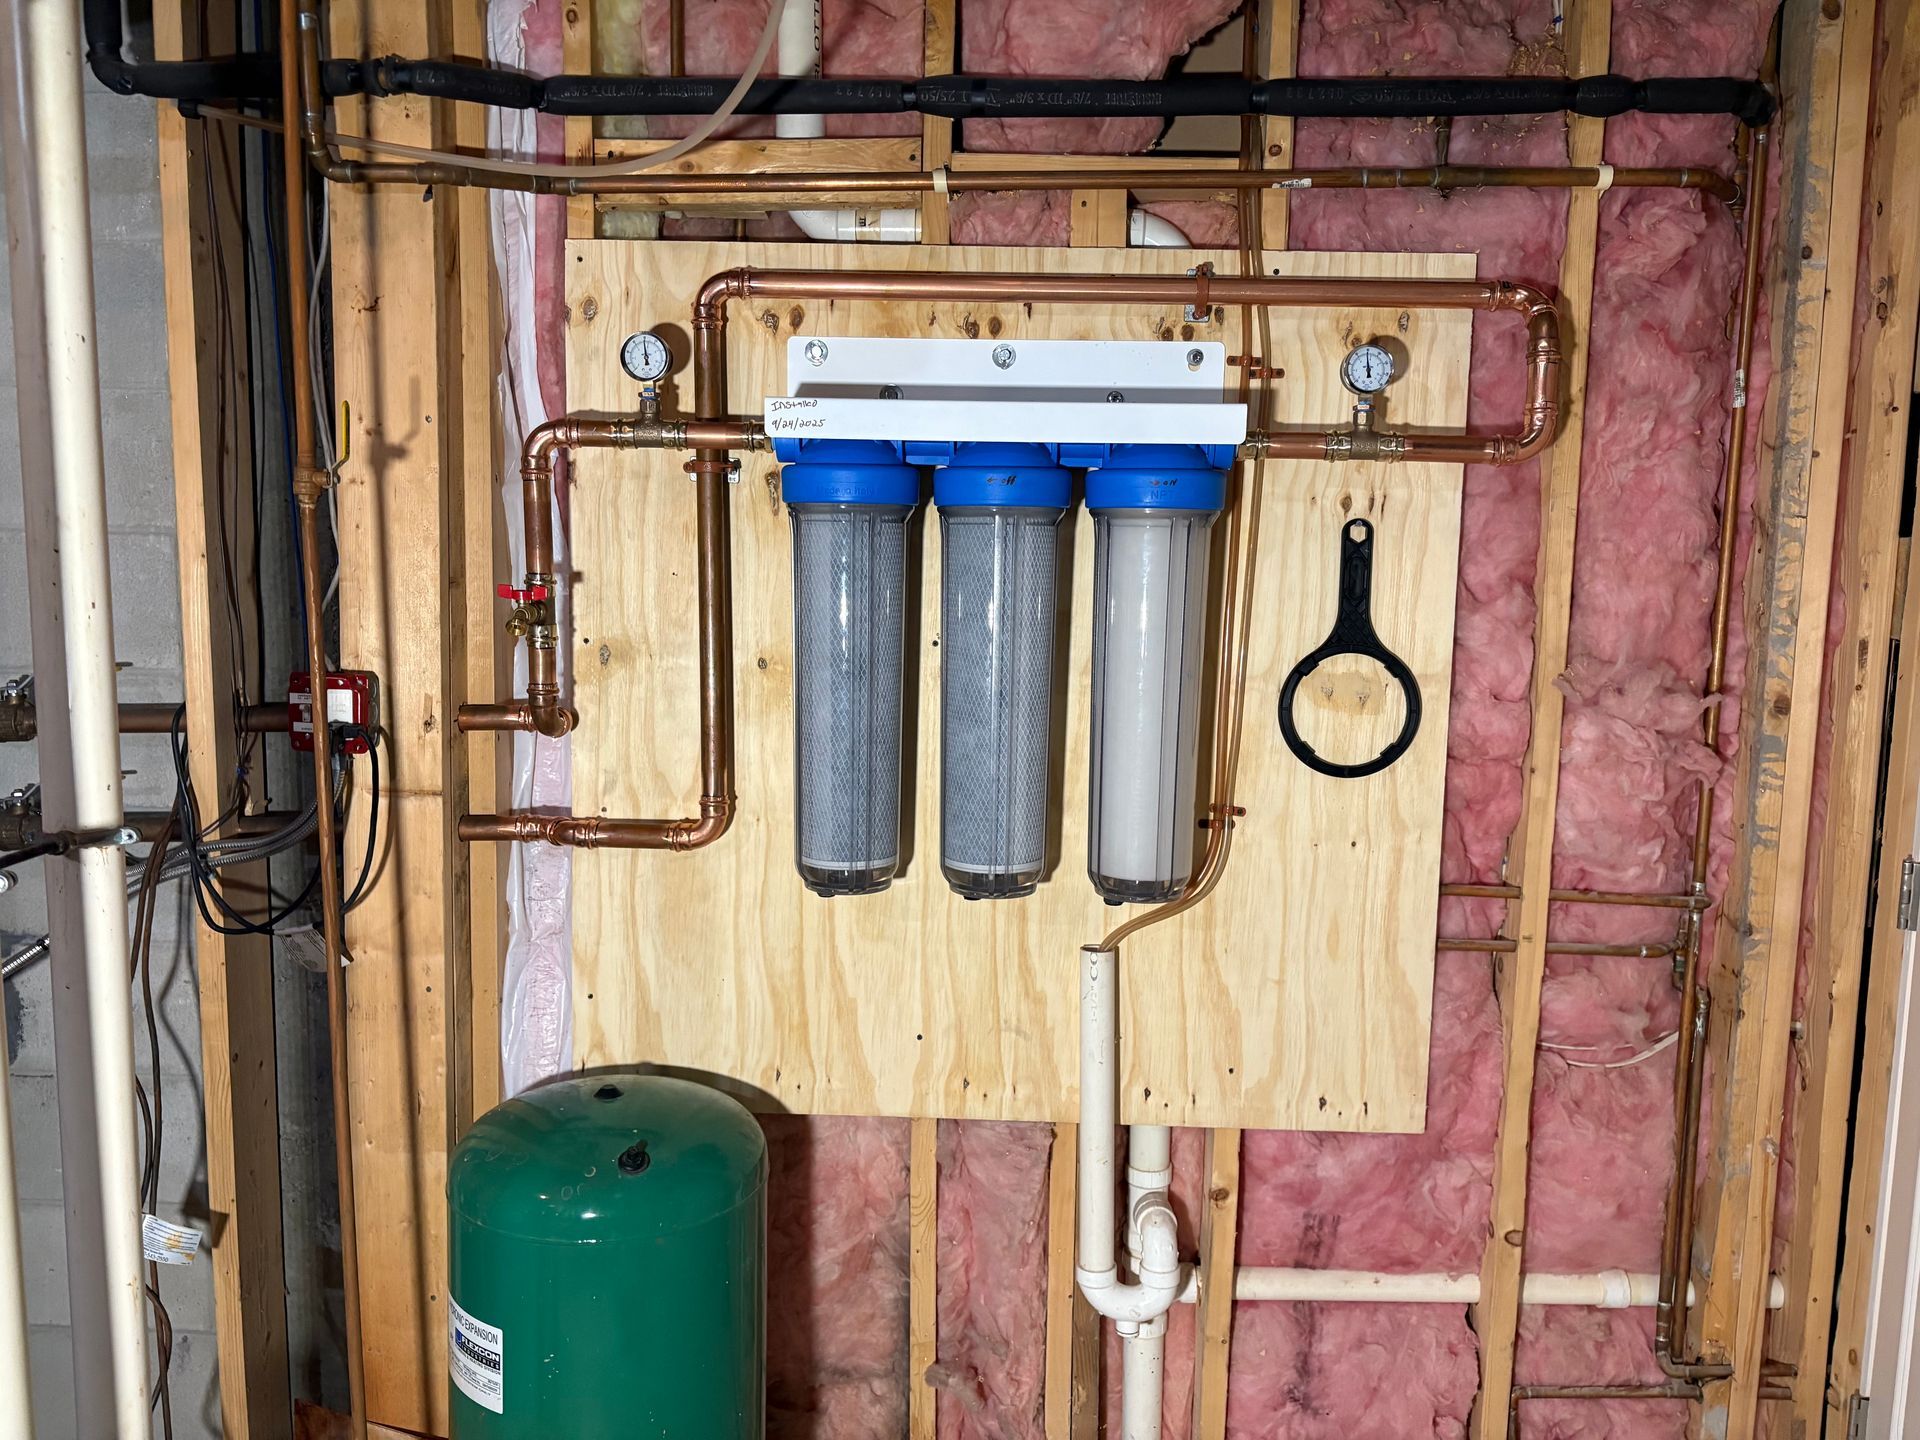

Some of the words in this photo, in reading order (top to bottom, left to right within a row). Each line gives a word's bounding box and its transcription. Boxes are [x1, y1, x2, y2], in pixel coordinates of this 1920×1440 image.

[771, 417, 826, 431] 9/24/2025
[465, 1319, 498, 1345] EXPANSION
[461, 1335, 500, 1362] FLEXCON
